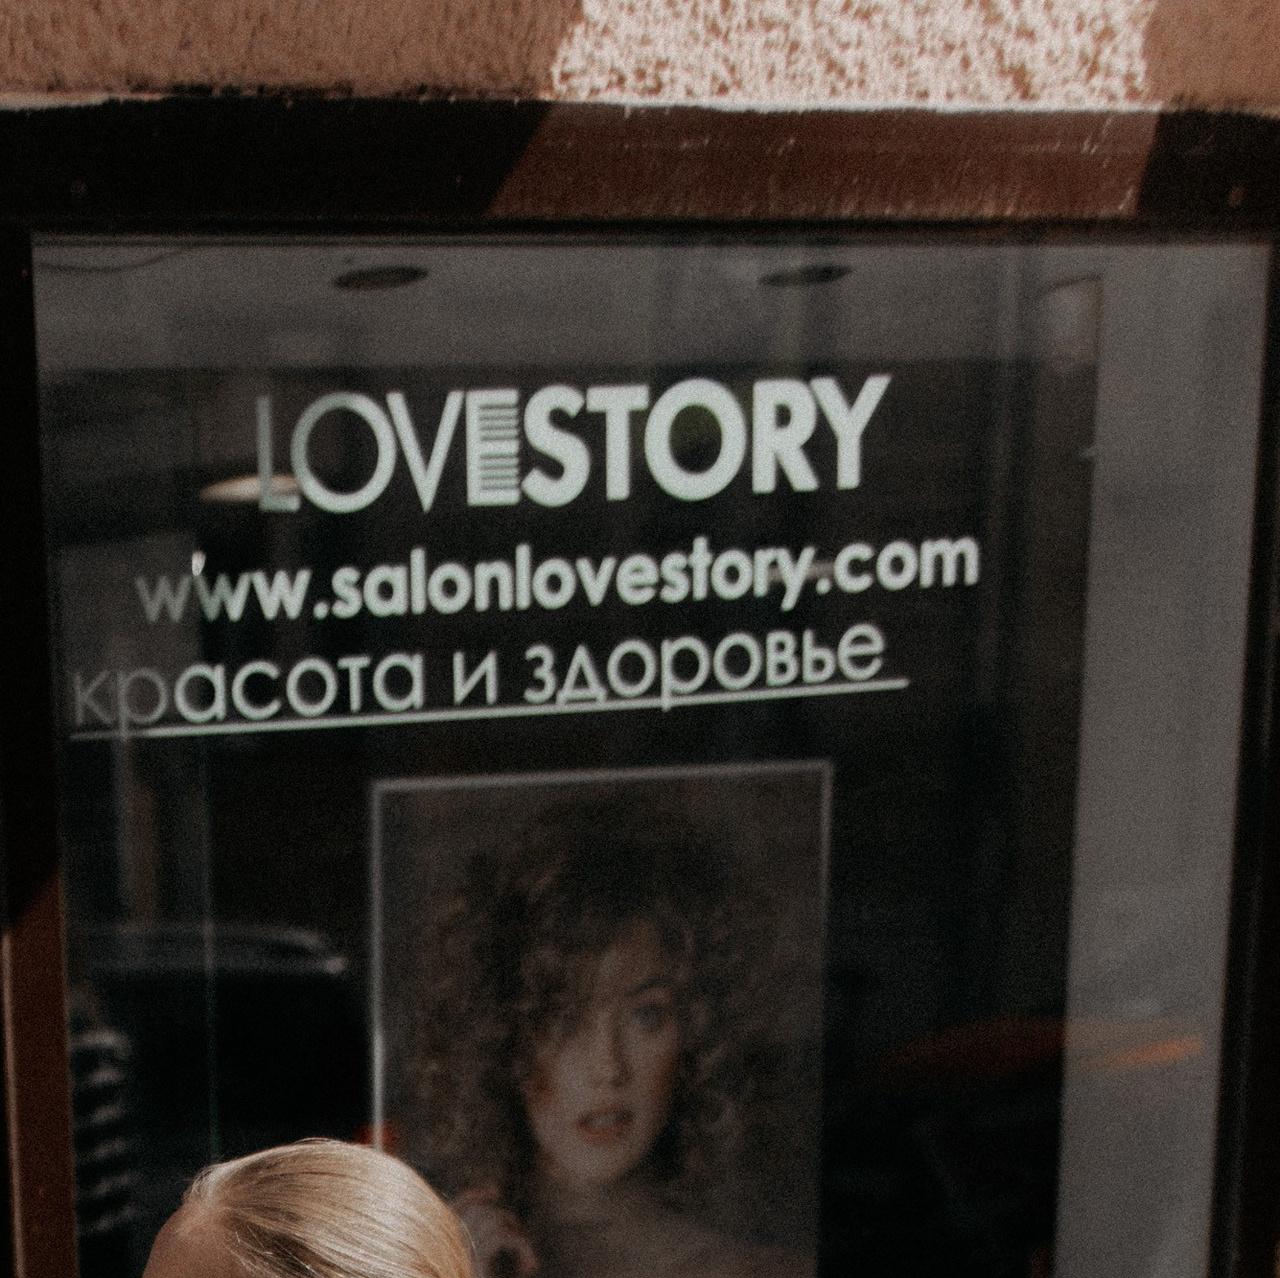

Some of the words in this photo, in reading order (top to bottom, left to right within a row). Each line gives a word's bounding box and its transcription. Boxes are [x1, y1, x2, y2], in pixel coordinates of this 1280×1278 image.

[256, 374, 892, 513] LOVESTORY
[136, 535, 980, 622] www.salonlovestory.com
[74, 652, 426, 732] красота
[452, 650, 499, 706] и
[523, 621, 886, 712] здоровье
